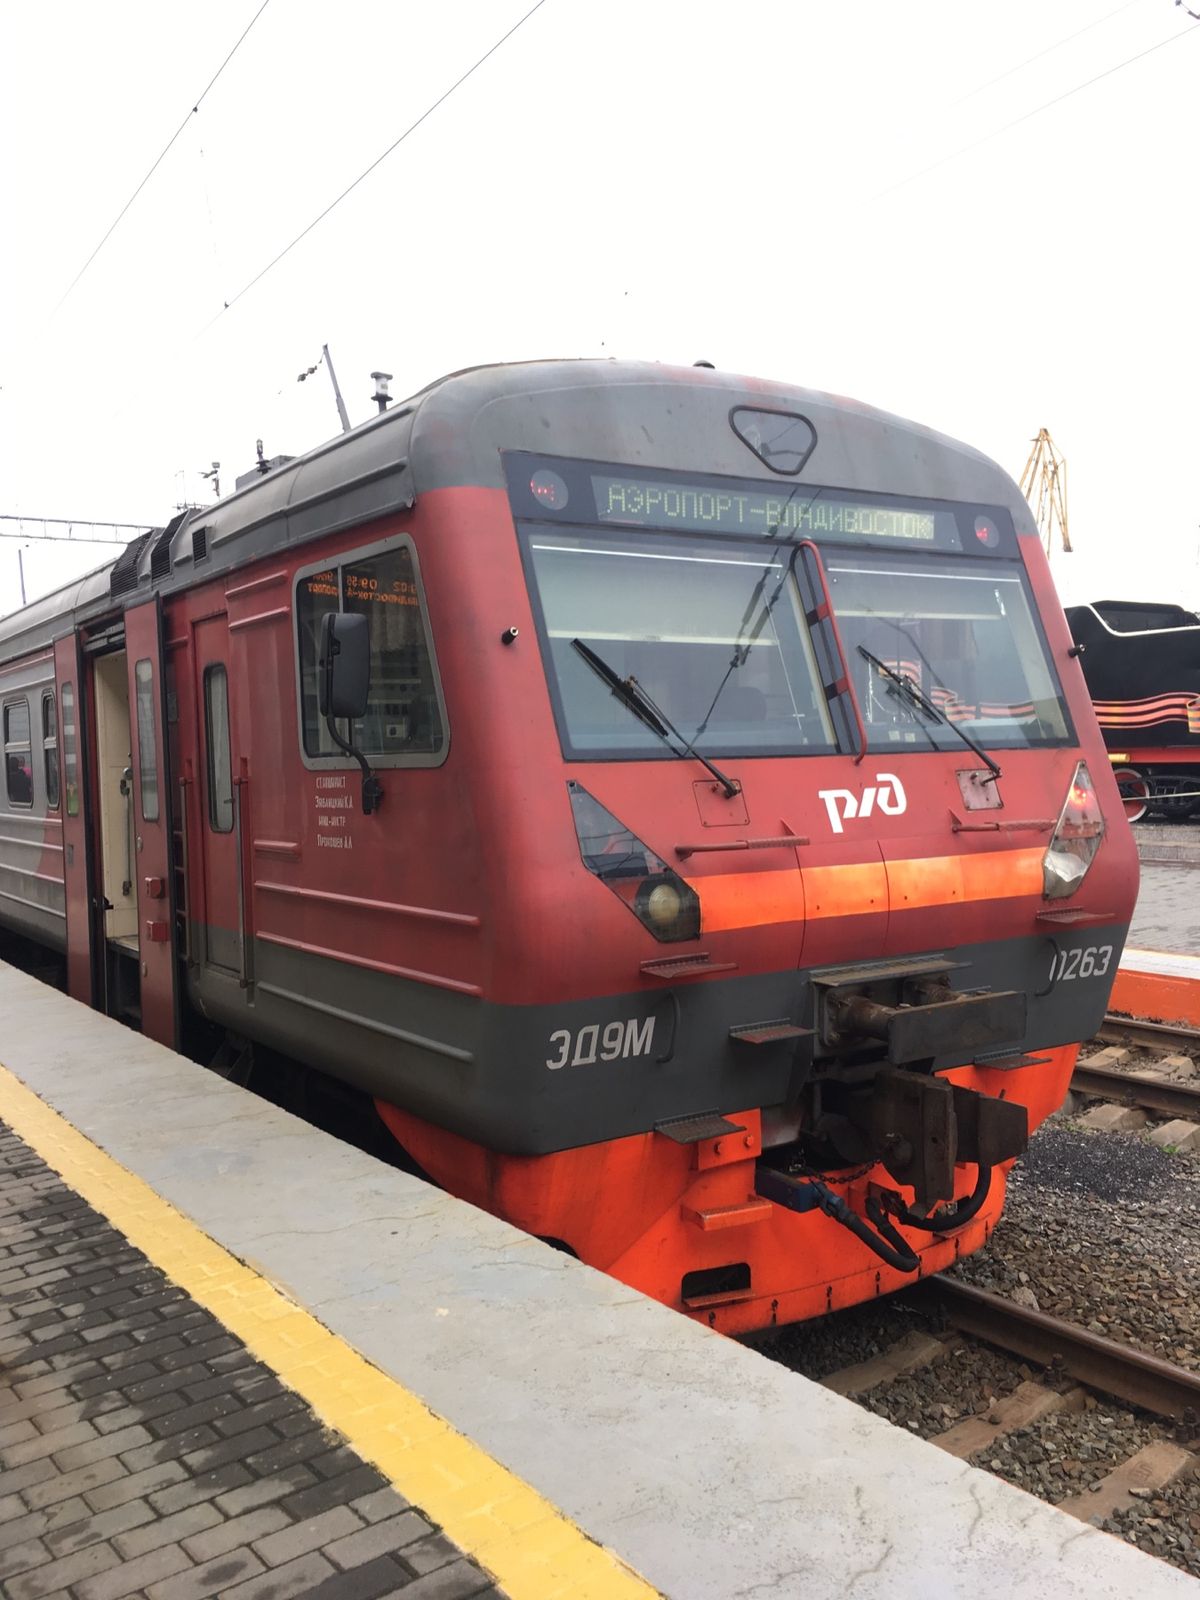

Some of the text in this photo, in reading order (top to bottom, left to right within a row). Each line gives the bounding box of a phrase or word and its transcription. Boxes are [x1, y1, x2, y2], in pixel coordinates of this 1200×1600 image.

[608, 484, 934, 539] АЭРОПОРТ-ВЛАДИВОСТОК
[818, 773, 907, 833] РЖД
[546, 1016, 656, 1071] ЭД9М
